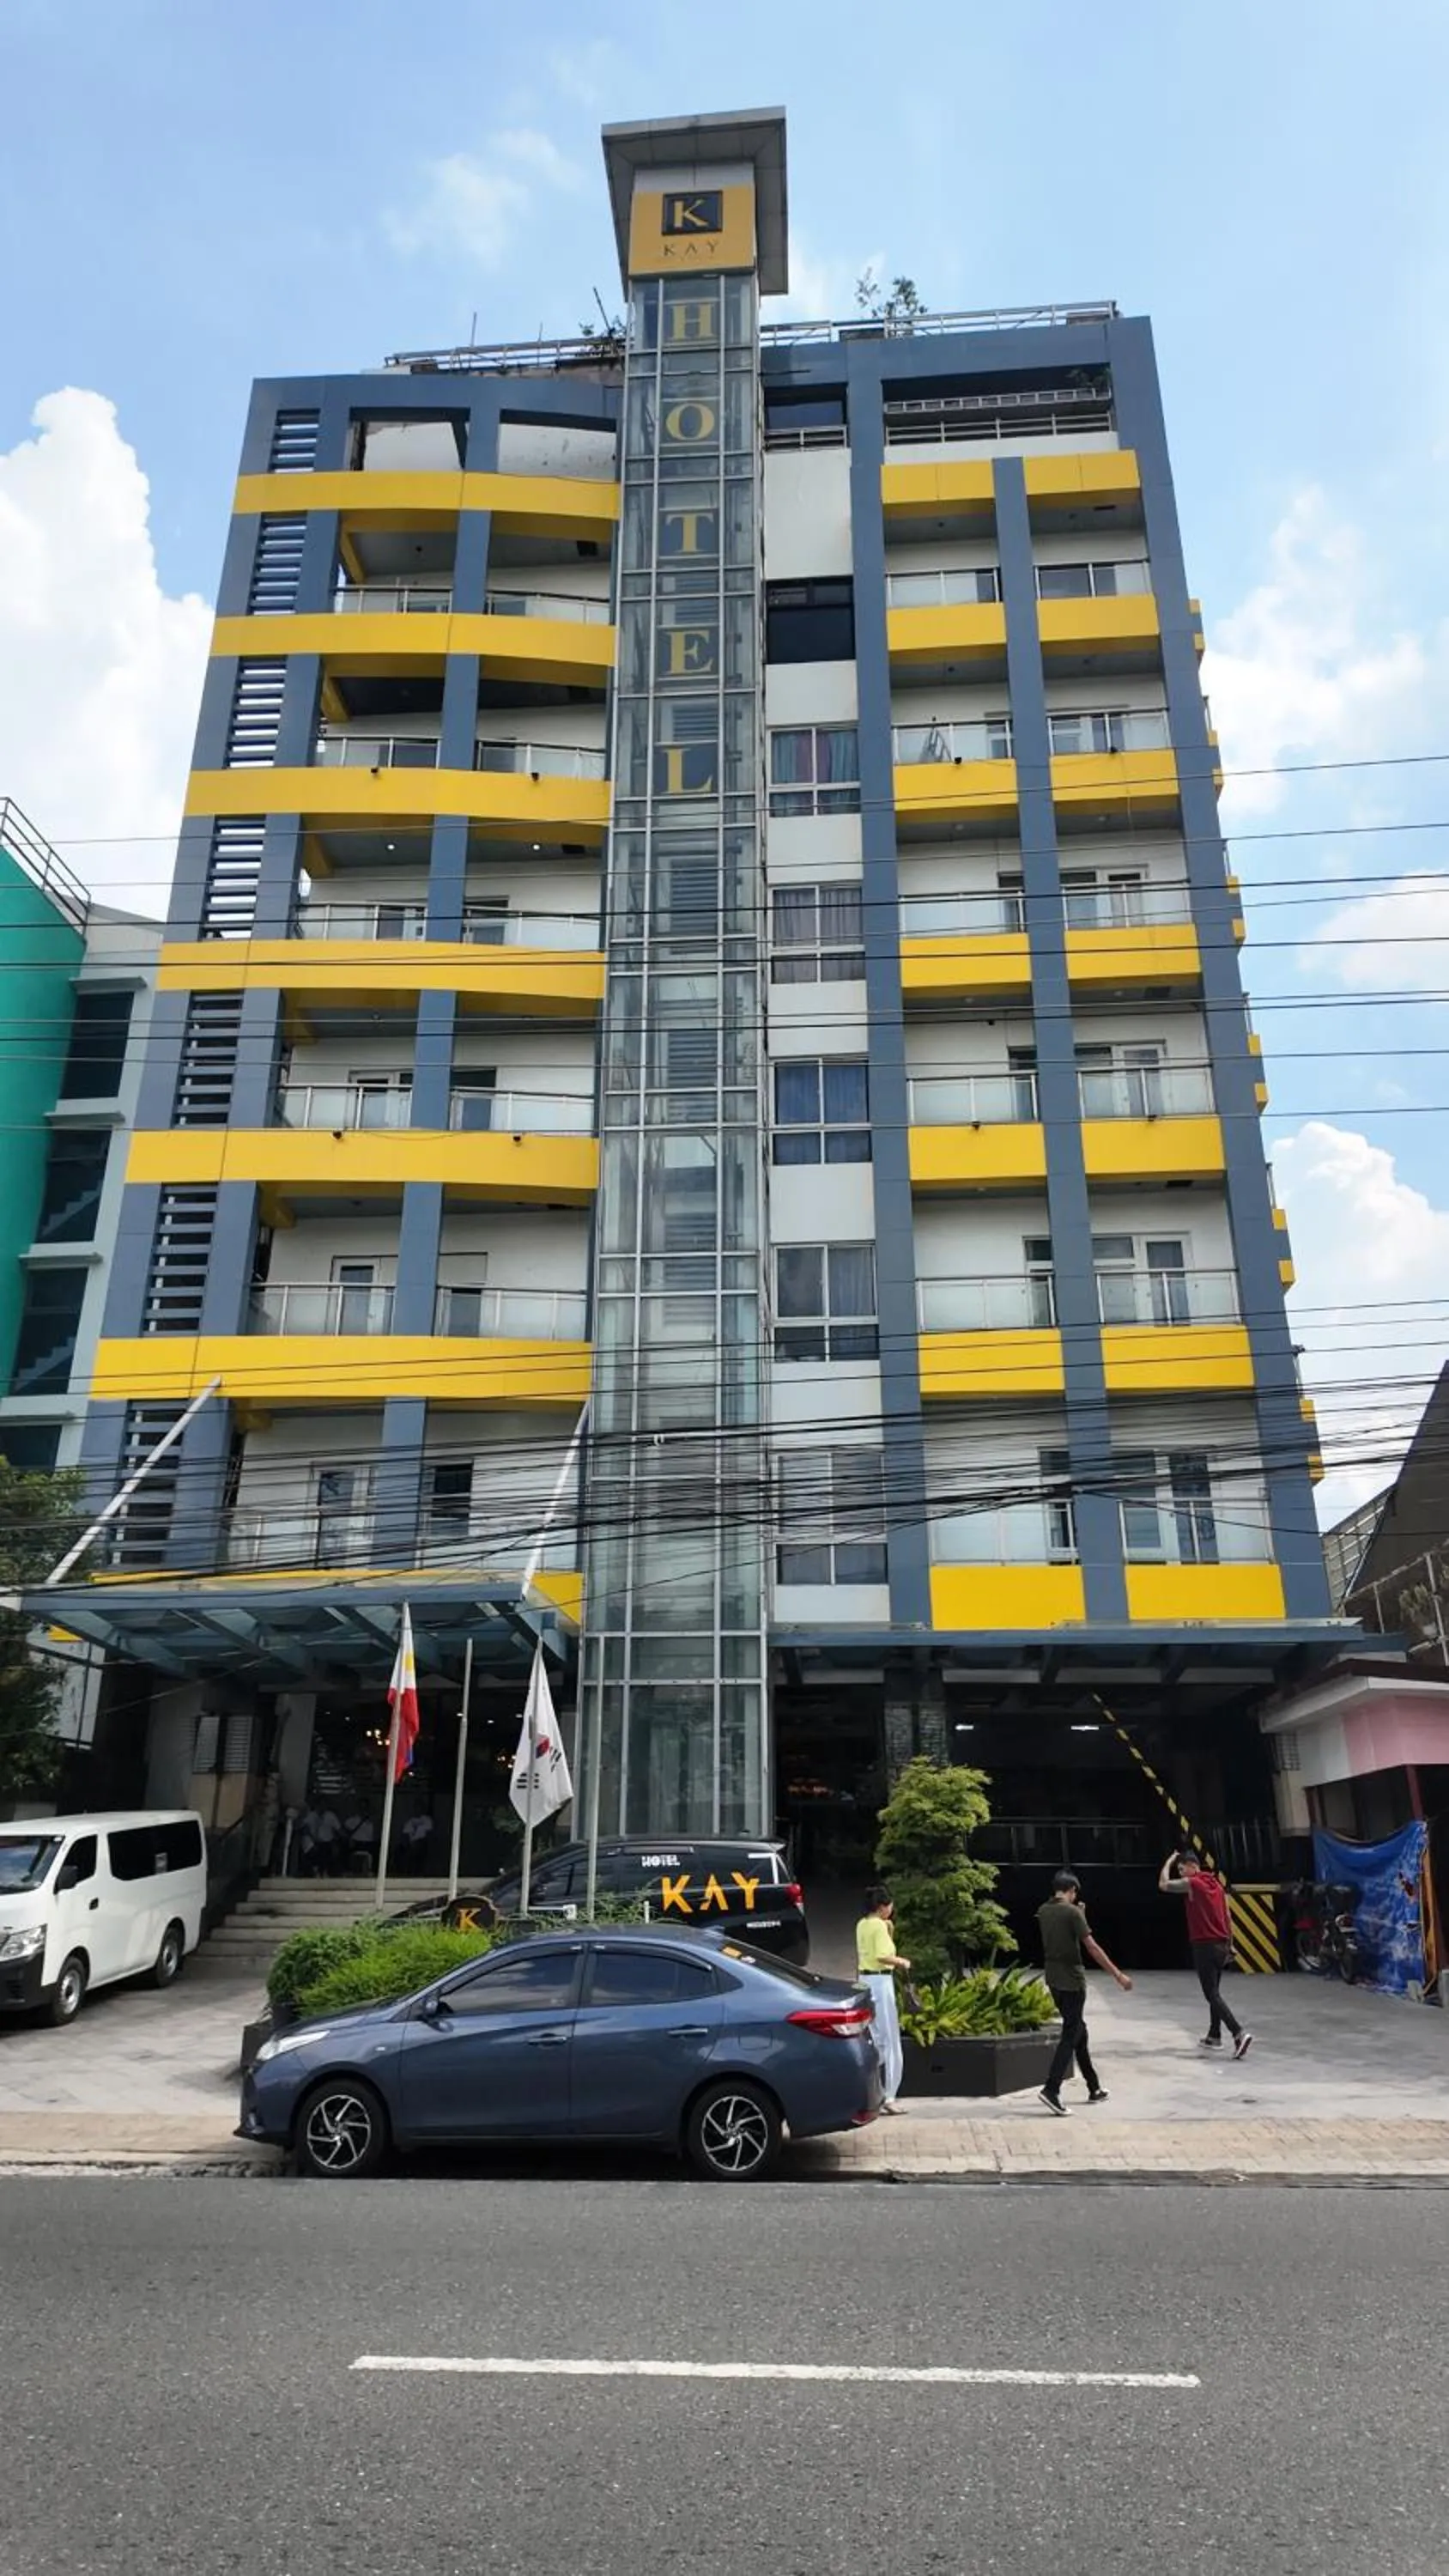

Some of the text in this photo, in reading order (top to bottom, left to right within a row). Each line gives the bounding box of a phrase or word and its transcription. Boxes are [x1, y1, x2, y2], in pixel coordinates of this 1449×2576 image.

[674, 199, 708, 228] K
[663, 240, 718, 256] KAY
[664, 303, 715, 794] HOTEL
[642, 1855, 680, 1867] HOTEL
[662, 1872, 760, 1912] KAY
[459, 1908, 482, 1933] K
